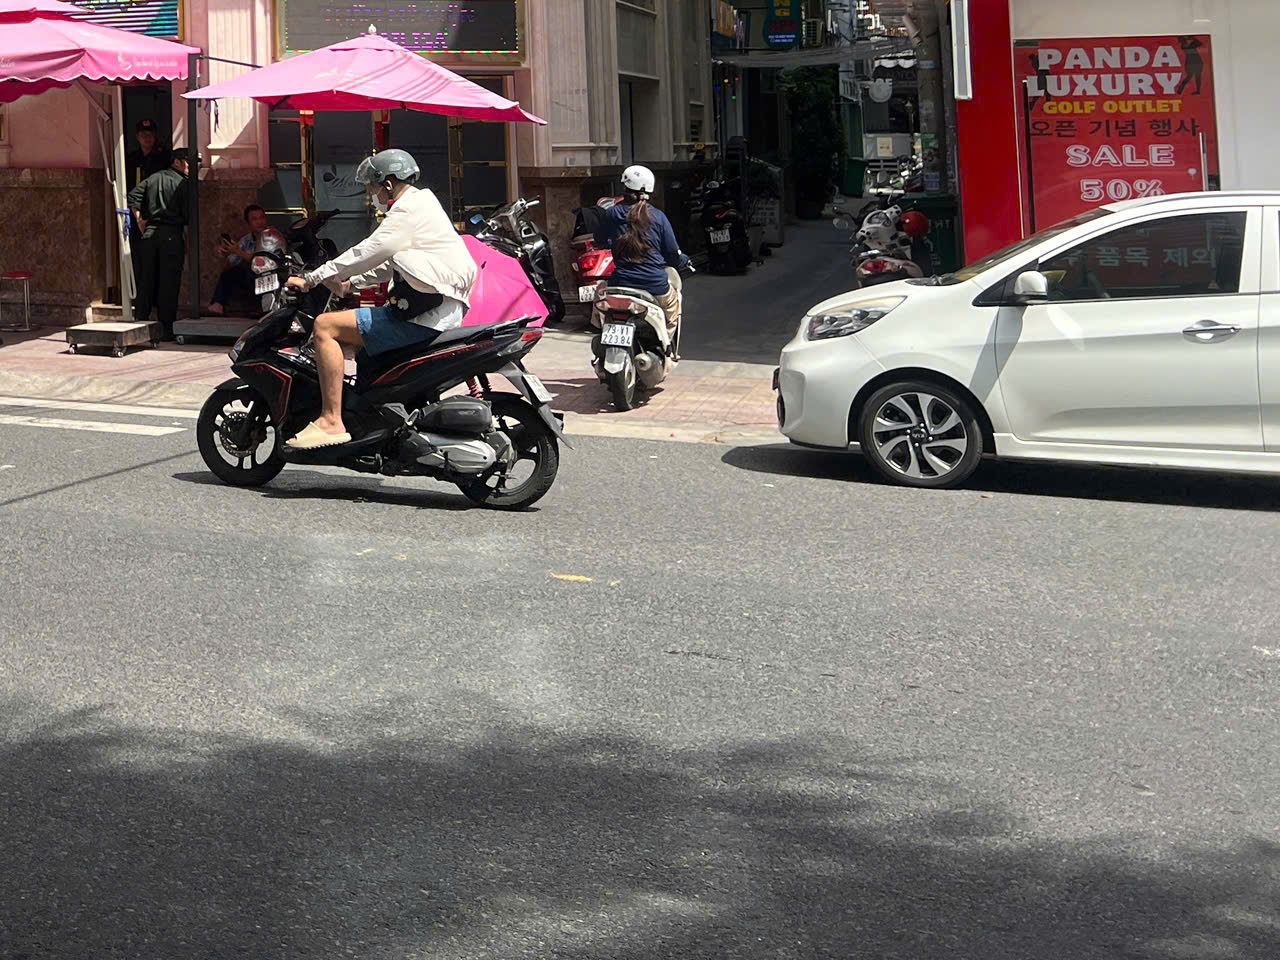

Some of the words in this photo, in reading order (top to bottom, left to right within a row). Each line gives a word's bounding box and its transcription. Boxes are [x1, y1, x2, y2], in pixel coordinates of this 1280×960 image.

[1037, 45, 1182, 70] PANDA
[1026, 72, 1182, 97] LUXURY
[1043, 100, 1096, 114] GOLF
[1103, 99, 1182, 113] OUTLET
[1030, 120, 1077, 137] 오픈
[1089, 119, 1137, 137] 기념
[1150, 118, 1200, 136] 행사
[1065, 143, 1175, 167] SALE
[1079, 178, 1166, 202] 50%
[1096, 247, 1150, 267] 품목
[1163, 247, 1217, 268] 제외
